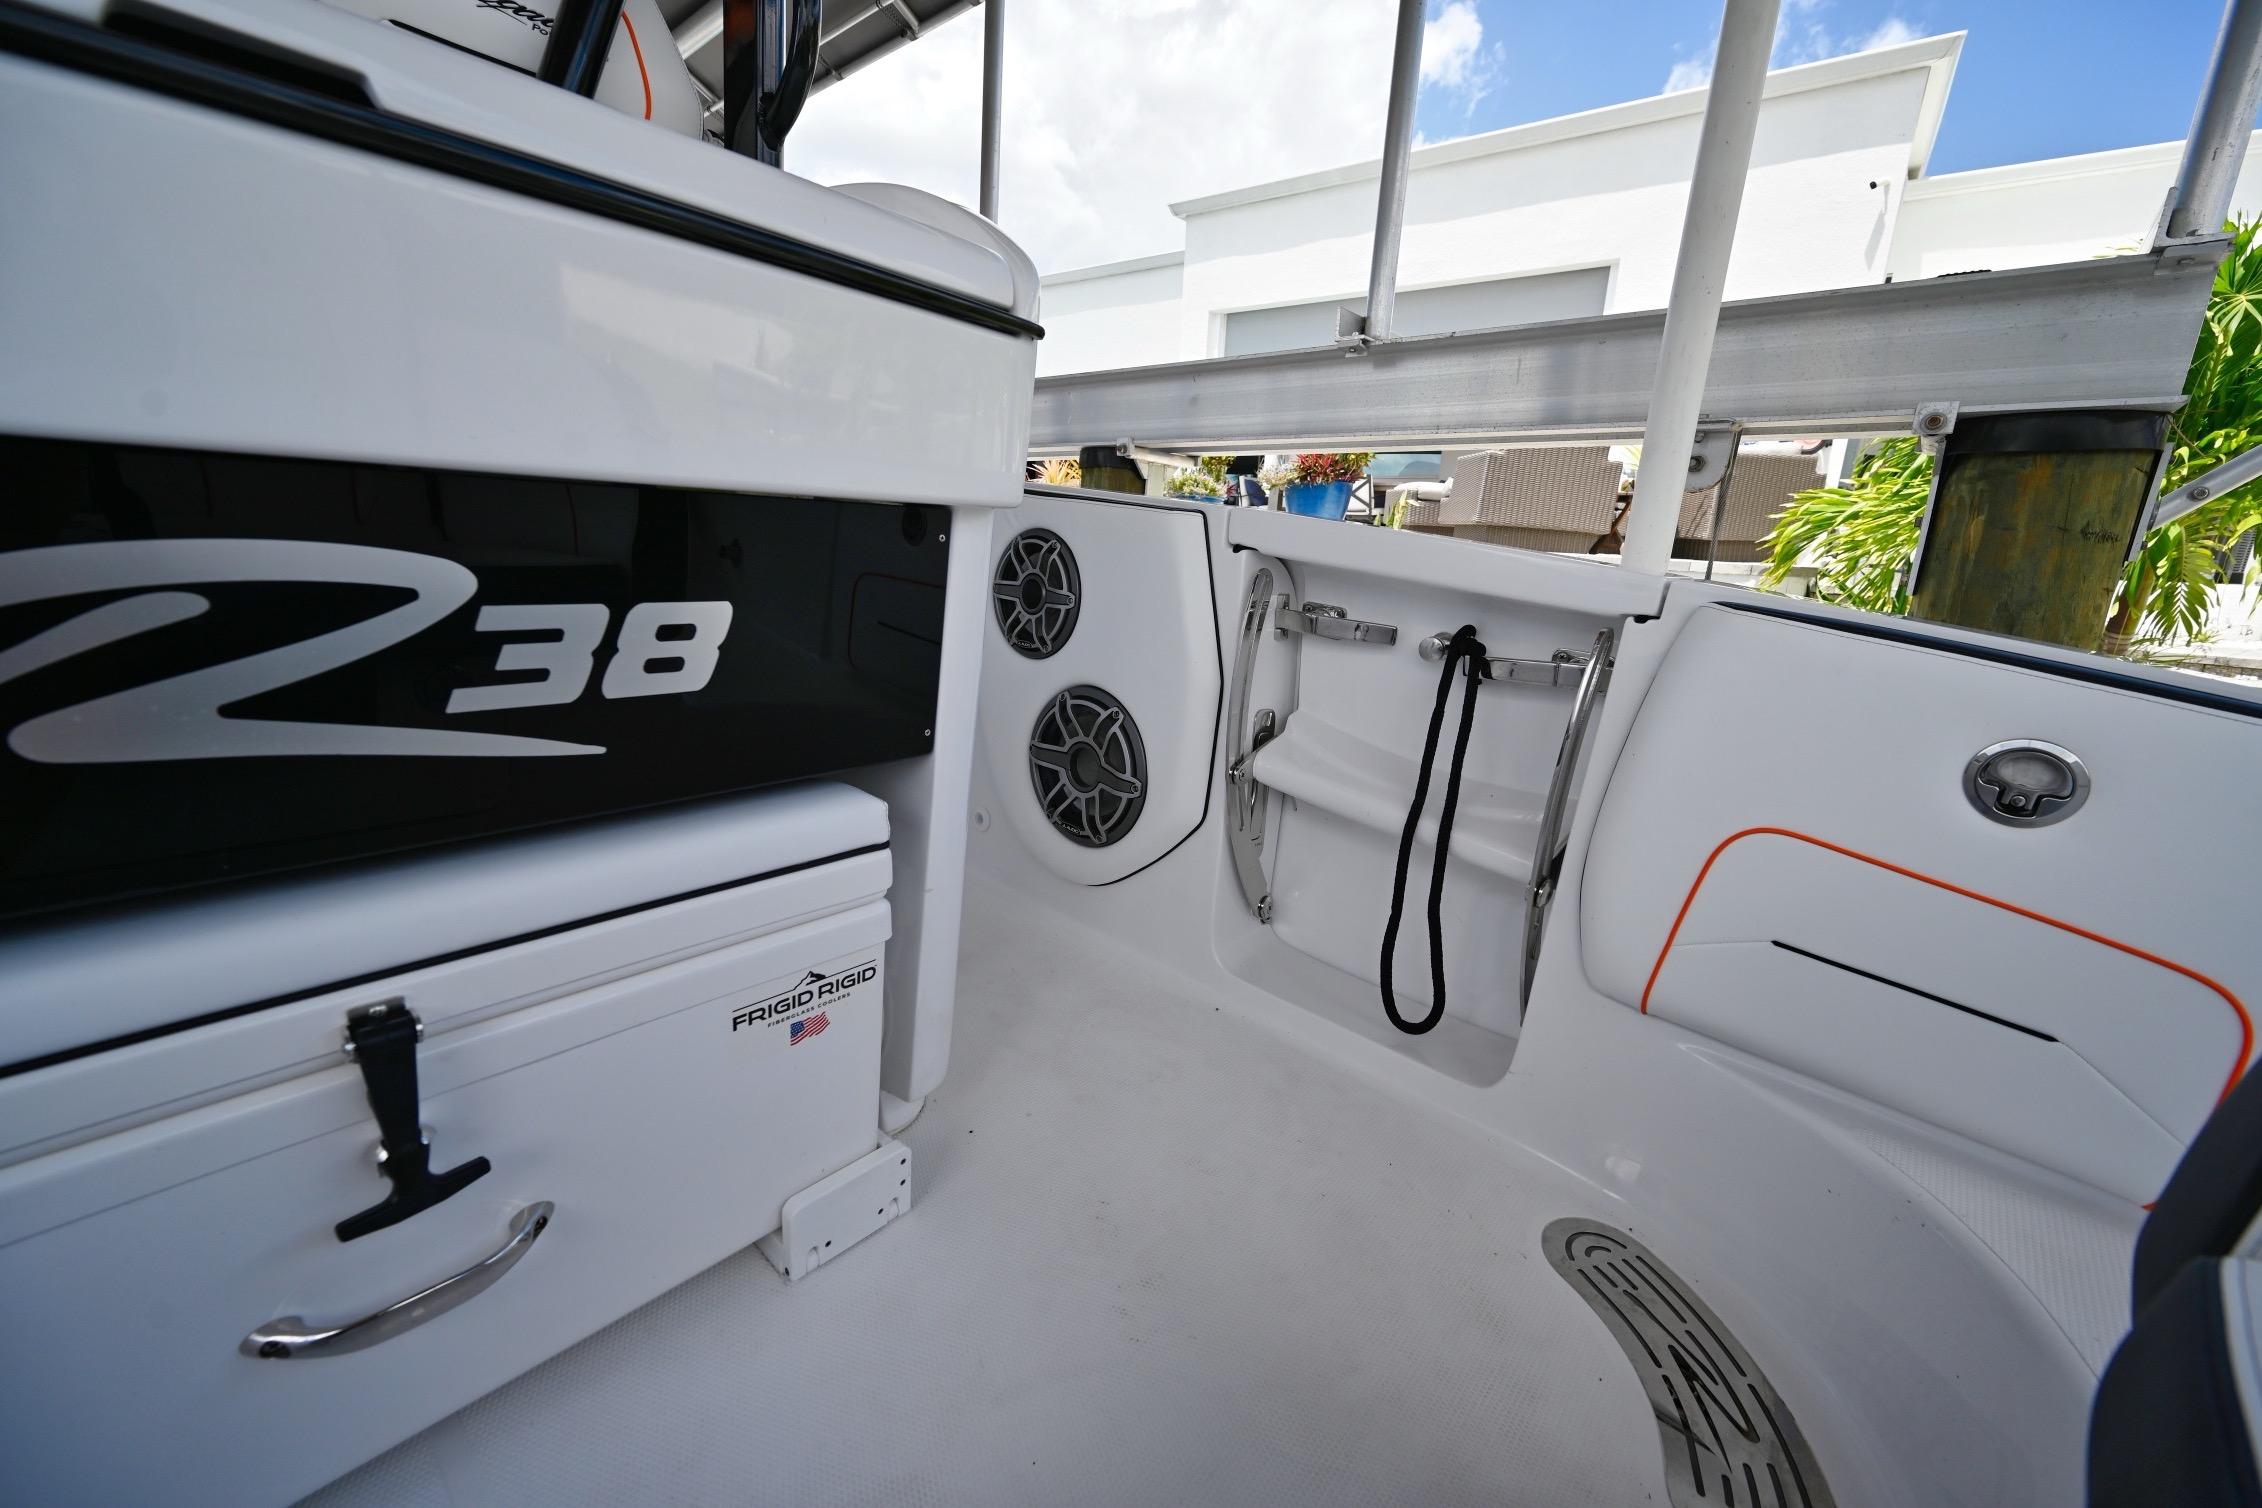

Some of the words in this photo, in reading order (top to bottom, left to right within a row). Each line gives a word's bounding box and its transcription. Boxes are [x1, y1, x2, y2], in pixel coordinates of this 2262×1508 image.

[732, 990, 814, 1032] FRIGID
[818, 966, 877, 1000] RIGID
[767, 1006, 815, 1028] FIBERGLASS
[817, 992, 851, 1009] COOLERS
